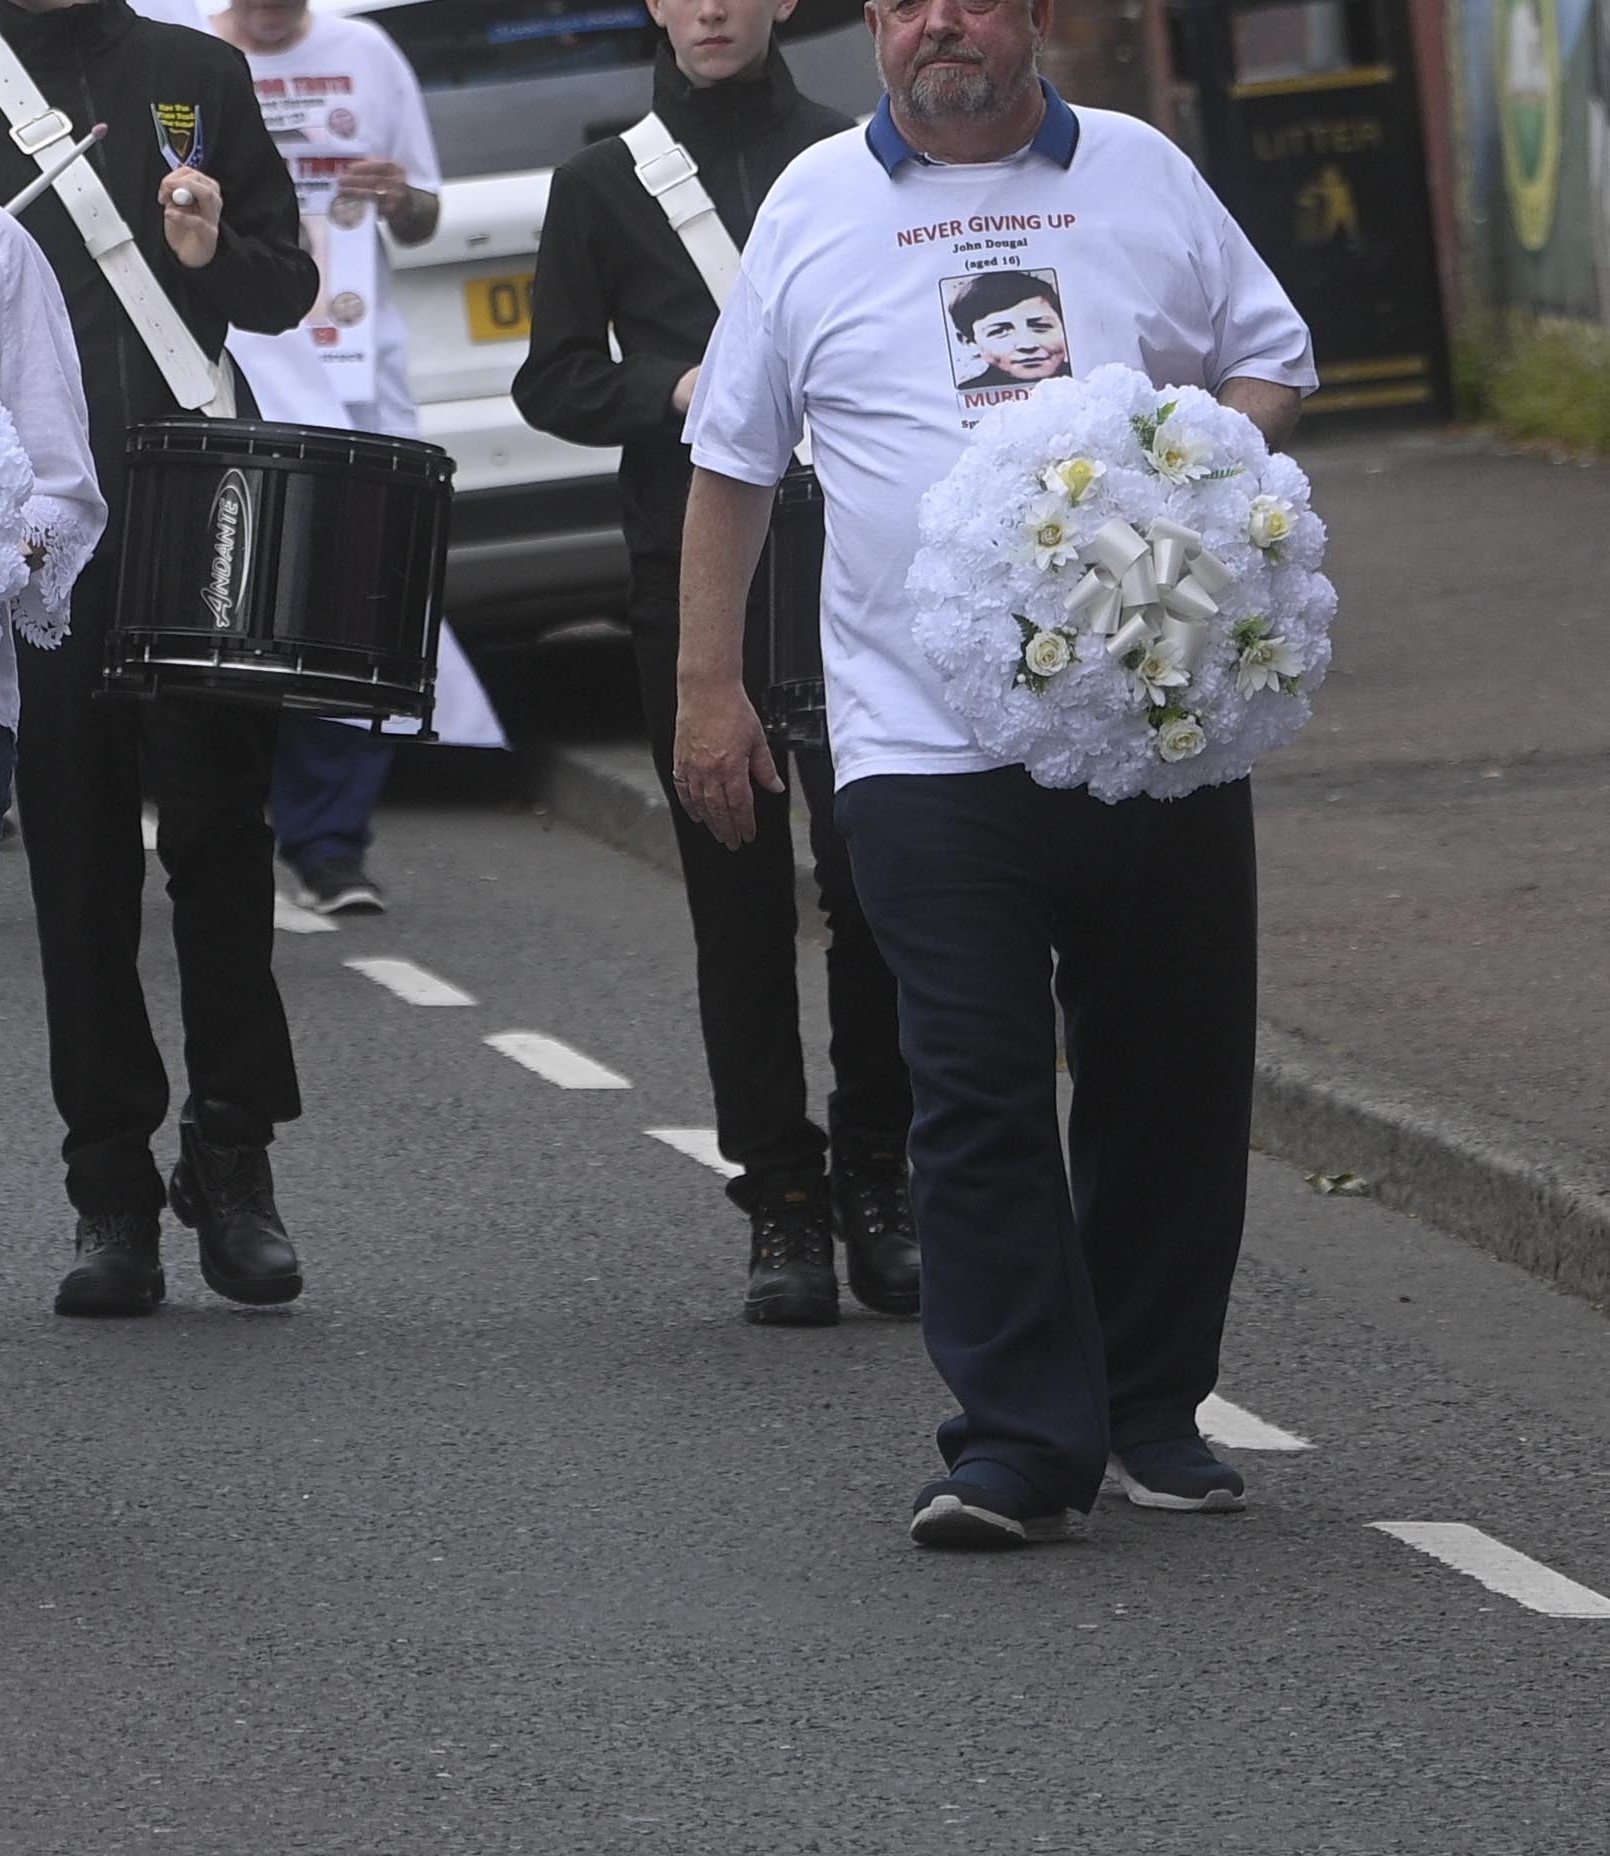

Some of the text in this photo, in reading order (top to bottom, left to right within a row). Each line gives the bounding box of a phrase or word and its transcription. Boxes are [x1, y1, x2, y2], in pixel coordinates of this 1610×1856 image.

[897, 214, 1076, 247] NEVER GIVING UP
[952, 237, 1029, 254] John Dougal
[965, 257, 998, 271] (aged
[964, 387, 1033, 409] MURD
